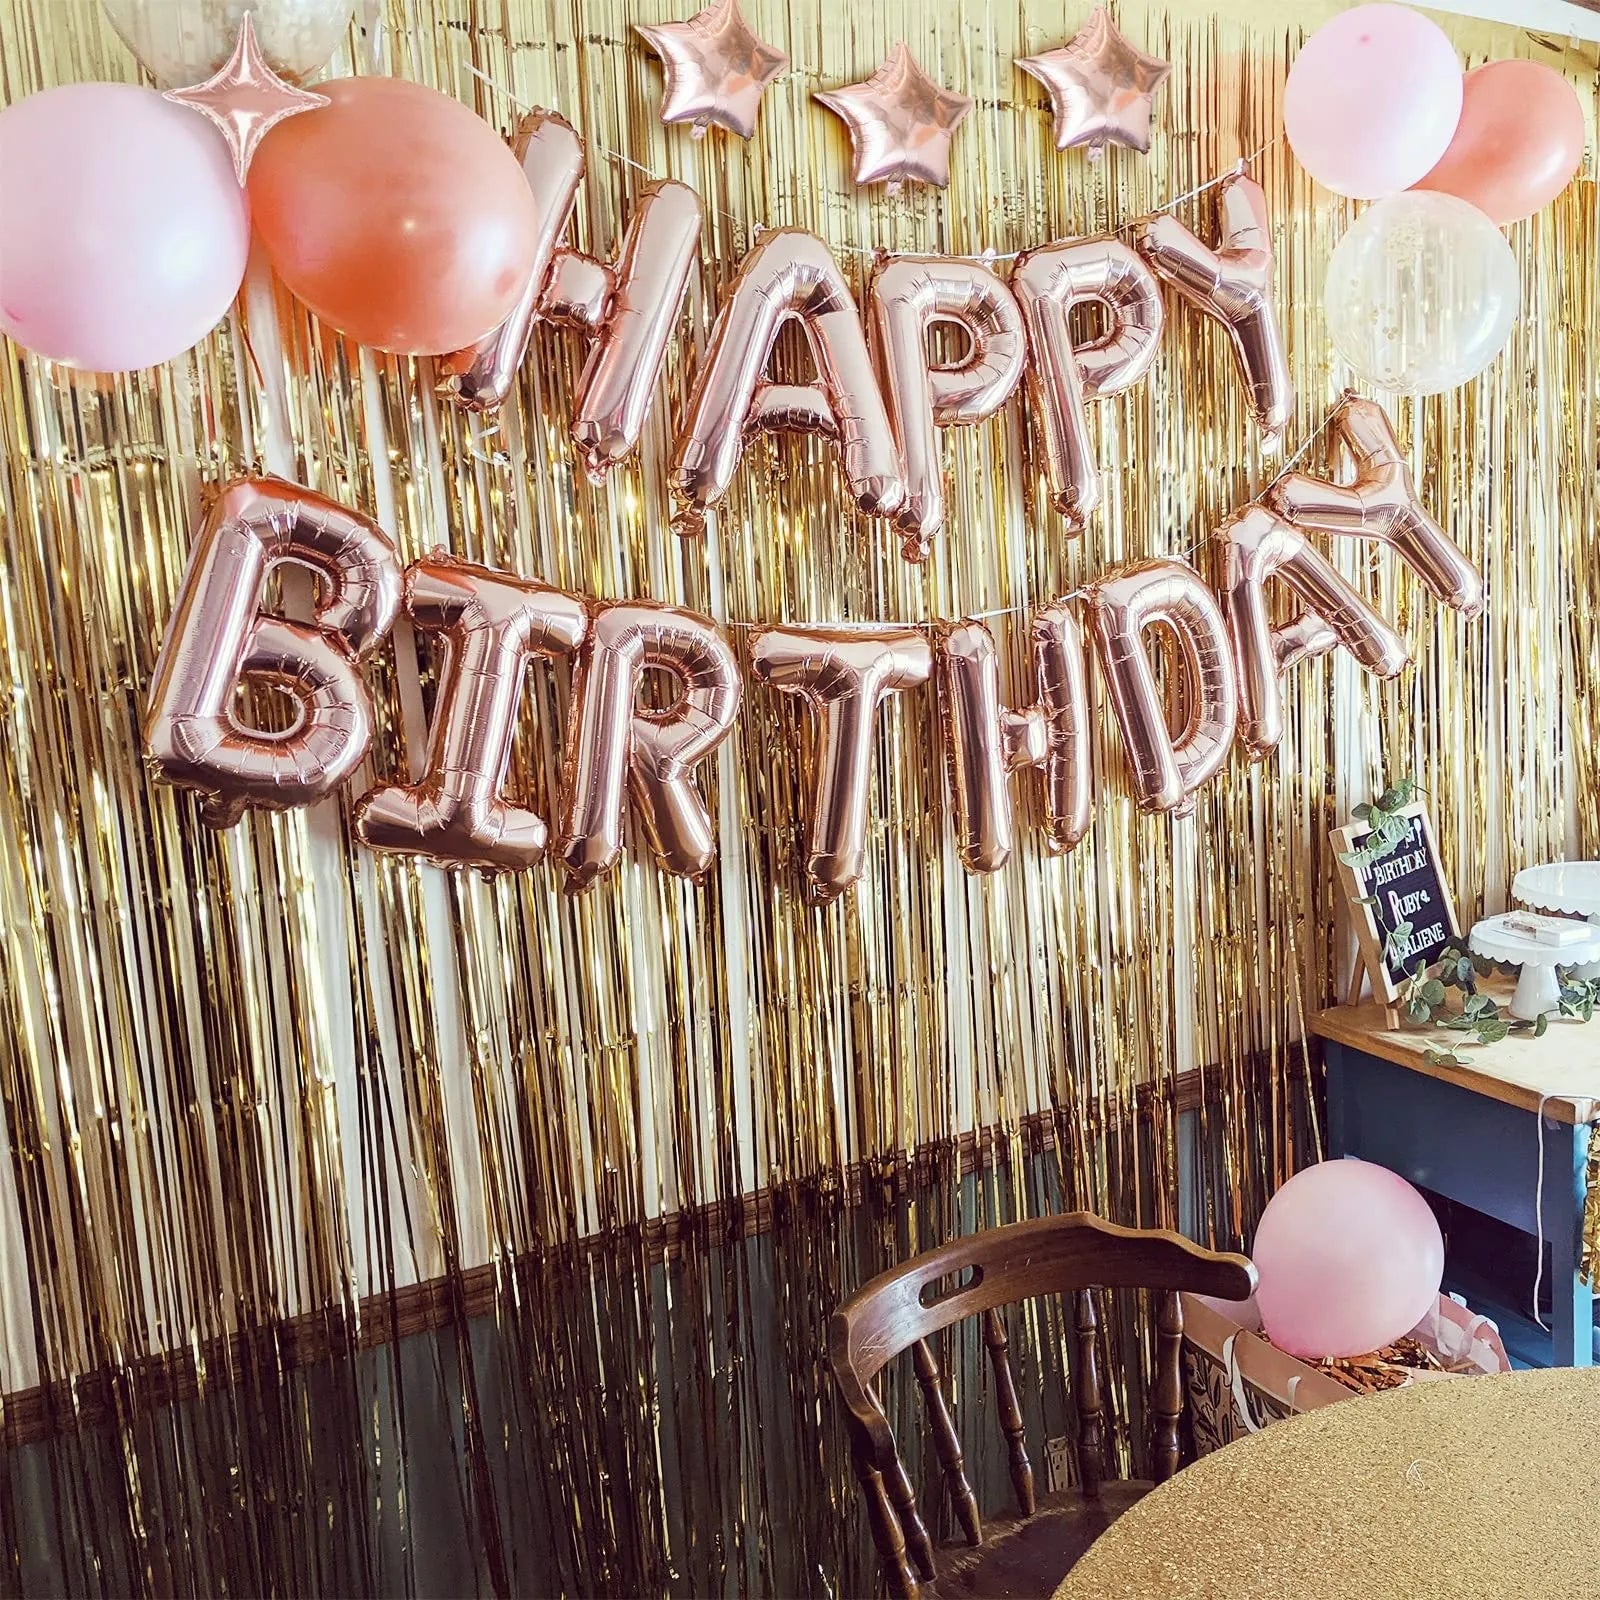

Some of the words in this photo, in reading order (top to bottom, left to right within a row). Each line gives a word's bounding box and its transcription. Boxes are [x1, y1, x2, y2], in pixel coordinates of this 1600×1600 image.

[438, 106, 1293, 562] HAPPY
[145, 390, 1482, 905] BIRTHDAY
[1373, 847, 1427, 886] BIRTHDAY
[1387, 890, 1422, 927] RUBY
